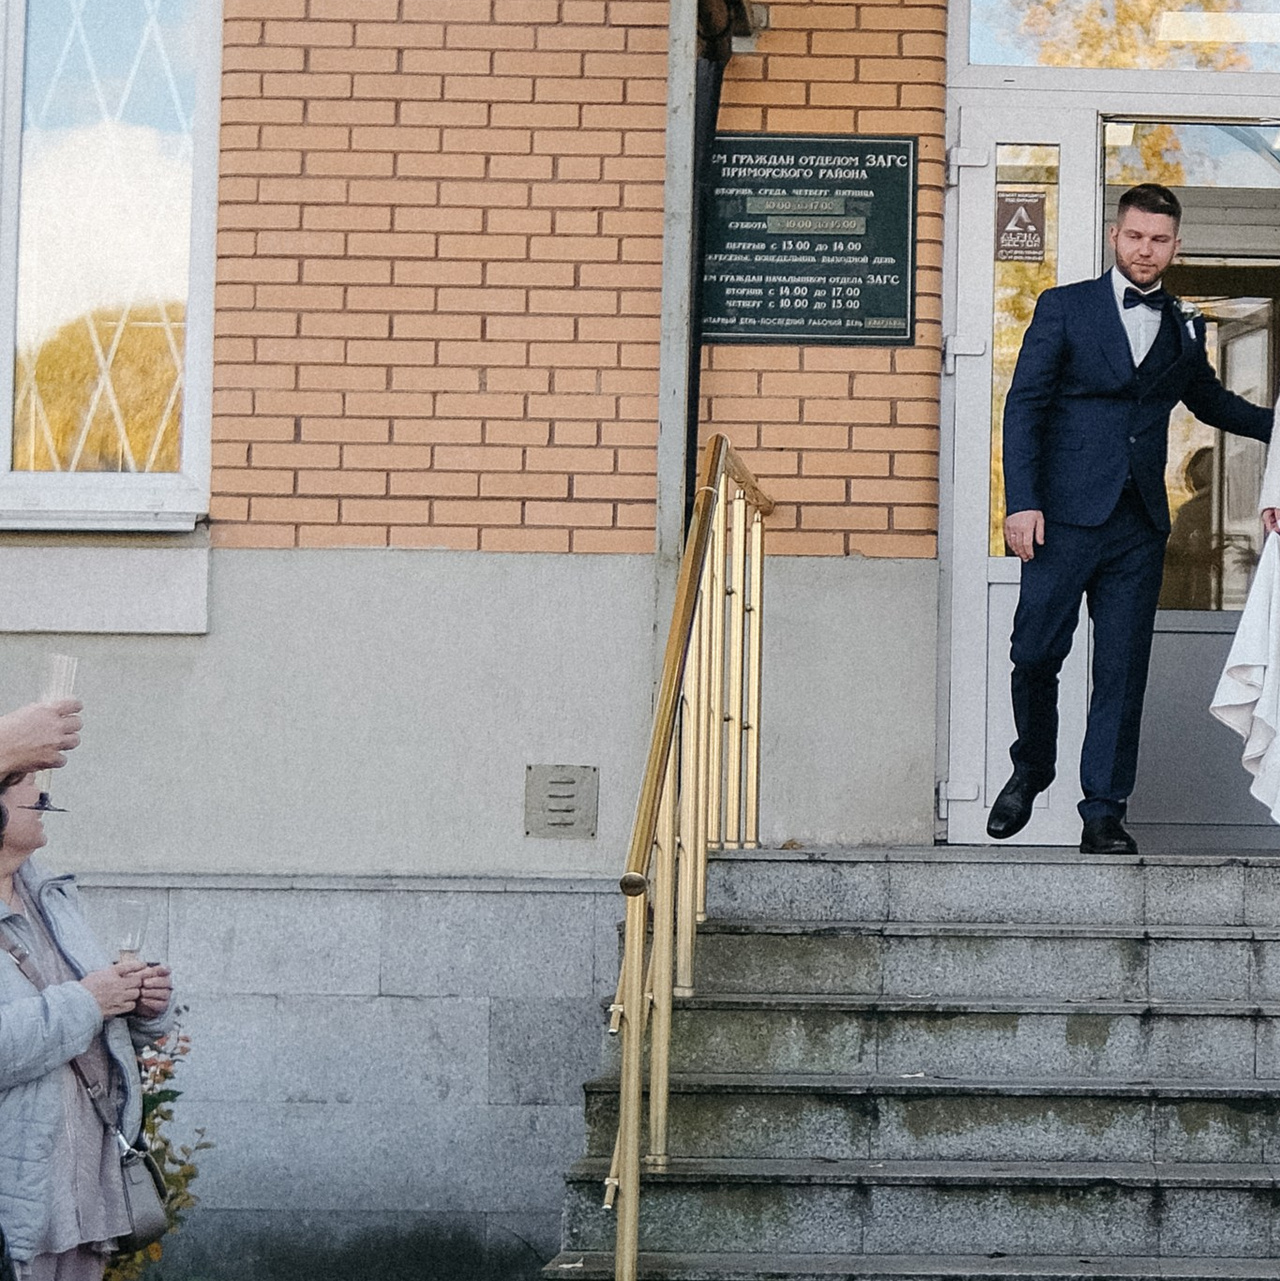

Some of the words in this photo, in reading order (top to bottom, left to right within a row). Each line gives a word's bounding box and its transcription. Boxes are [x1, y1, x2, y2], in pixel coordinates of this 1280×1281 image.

[731, 154, 795, 166] ГРАЖДАН
[798, 155, 859, 167] ОТДЕЛОМ
[865, 154, 908, 168] ЗАГС
[721, 167, 813, 179] ПРИМОРСКОГО
[818, 167, 868, 179] РАЙОНА
[714, 188, 753, 196] ВТОРНИК
[758, 188, 787, 196] СРЕДА
[792, 189, 830, 197] ЧЕТВЕРГ
[834, 189, 875, 197] ПЯТНИЦА
[728, 221, 768, 229] СУББОТА
[1000, 232, 1041, 241] ALPHA
[725, 242, 766, 250] ПЕРЕРЫВ
[814, 243, 829, 252] до
[821, 255, 869, 263] ВЫХОДНОЙ
[872, 256, 896, 265] ДЕНЬ
[719, 275, 763, 283] ГРАЖДАН
[765, 275, 827, 284] НАЧАЛЬНИКОМ
[829, 276, 863, 284] ОТДЕЛА
[867, 274, 900, 285] ЗАГС
[725, 288, 763, 296] ВТОРНИК
[768, 288, 775, 296] с
[779, 286, 808, 296] 14.00
[813, 289, 827, 297] до
[832, 287, 860, 297] 17.00
[725, 300, 763, 308] ЧЕТВЕРГ
[779, 298, 809, 308] 10.00
